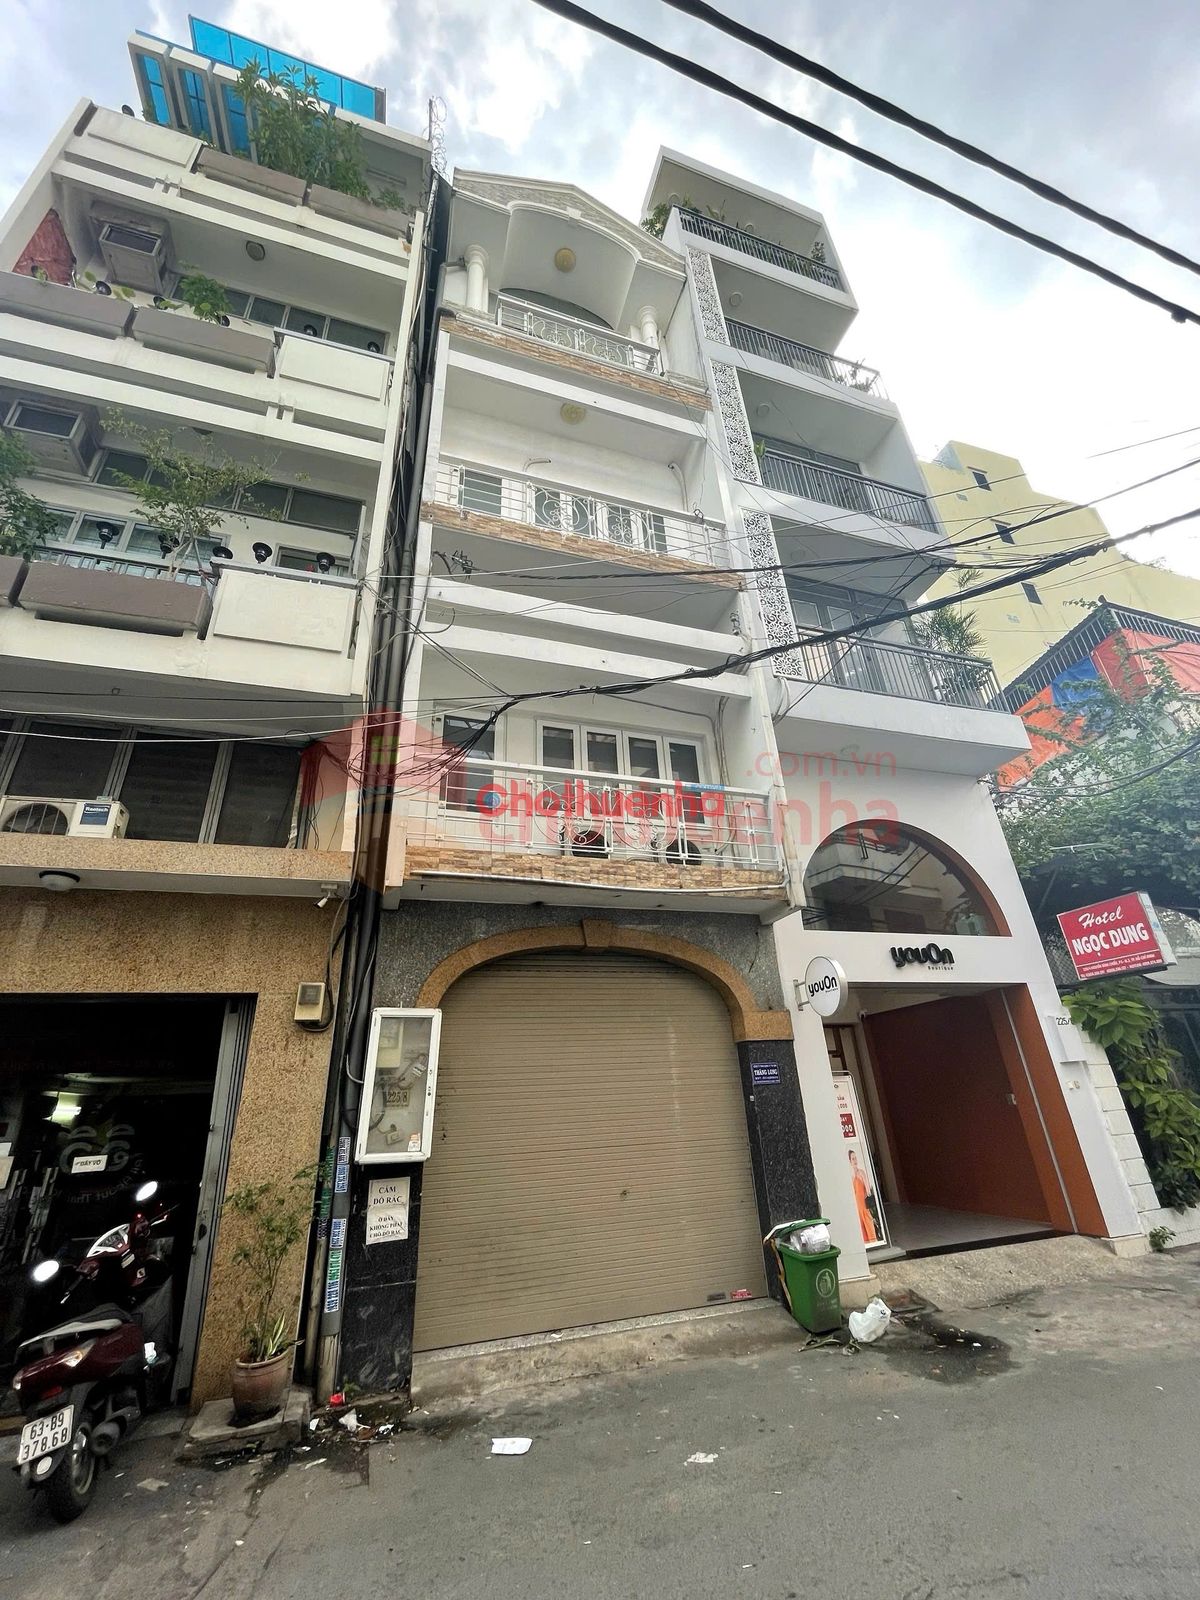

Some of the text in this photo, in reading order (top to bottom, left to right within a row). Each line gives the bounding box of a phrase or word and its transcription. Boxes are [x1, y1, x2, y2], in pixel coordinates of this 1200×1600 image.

[1078, 905, 1124, 929] Hotel
[1071, 922, 1150, 956] NGỌC DUNG
[889, 943, 955, 967] youOn
[808, 975, 838, 997] youOn
[22, 1427, 68, 1460] 378.68
